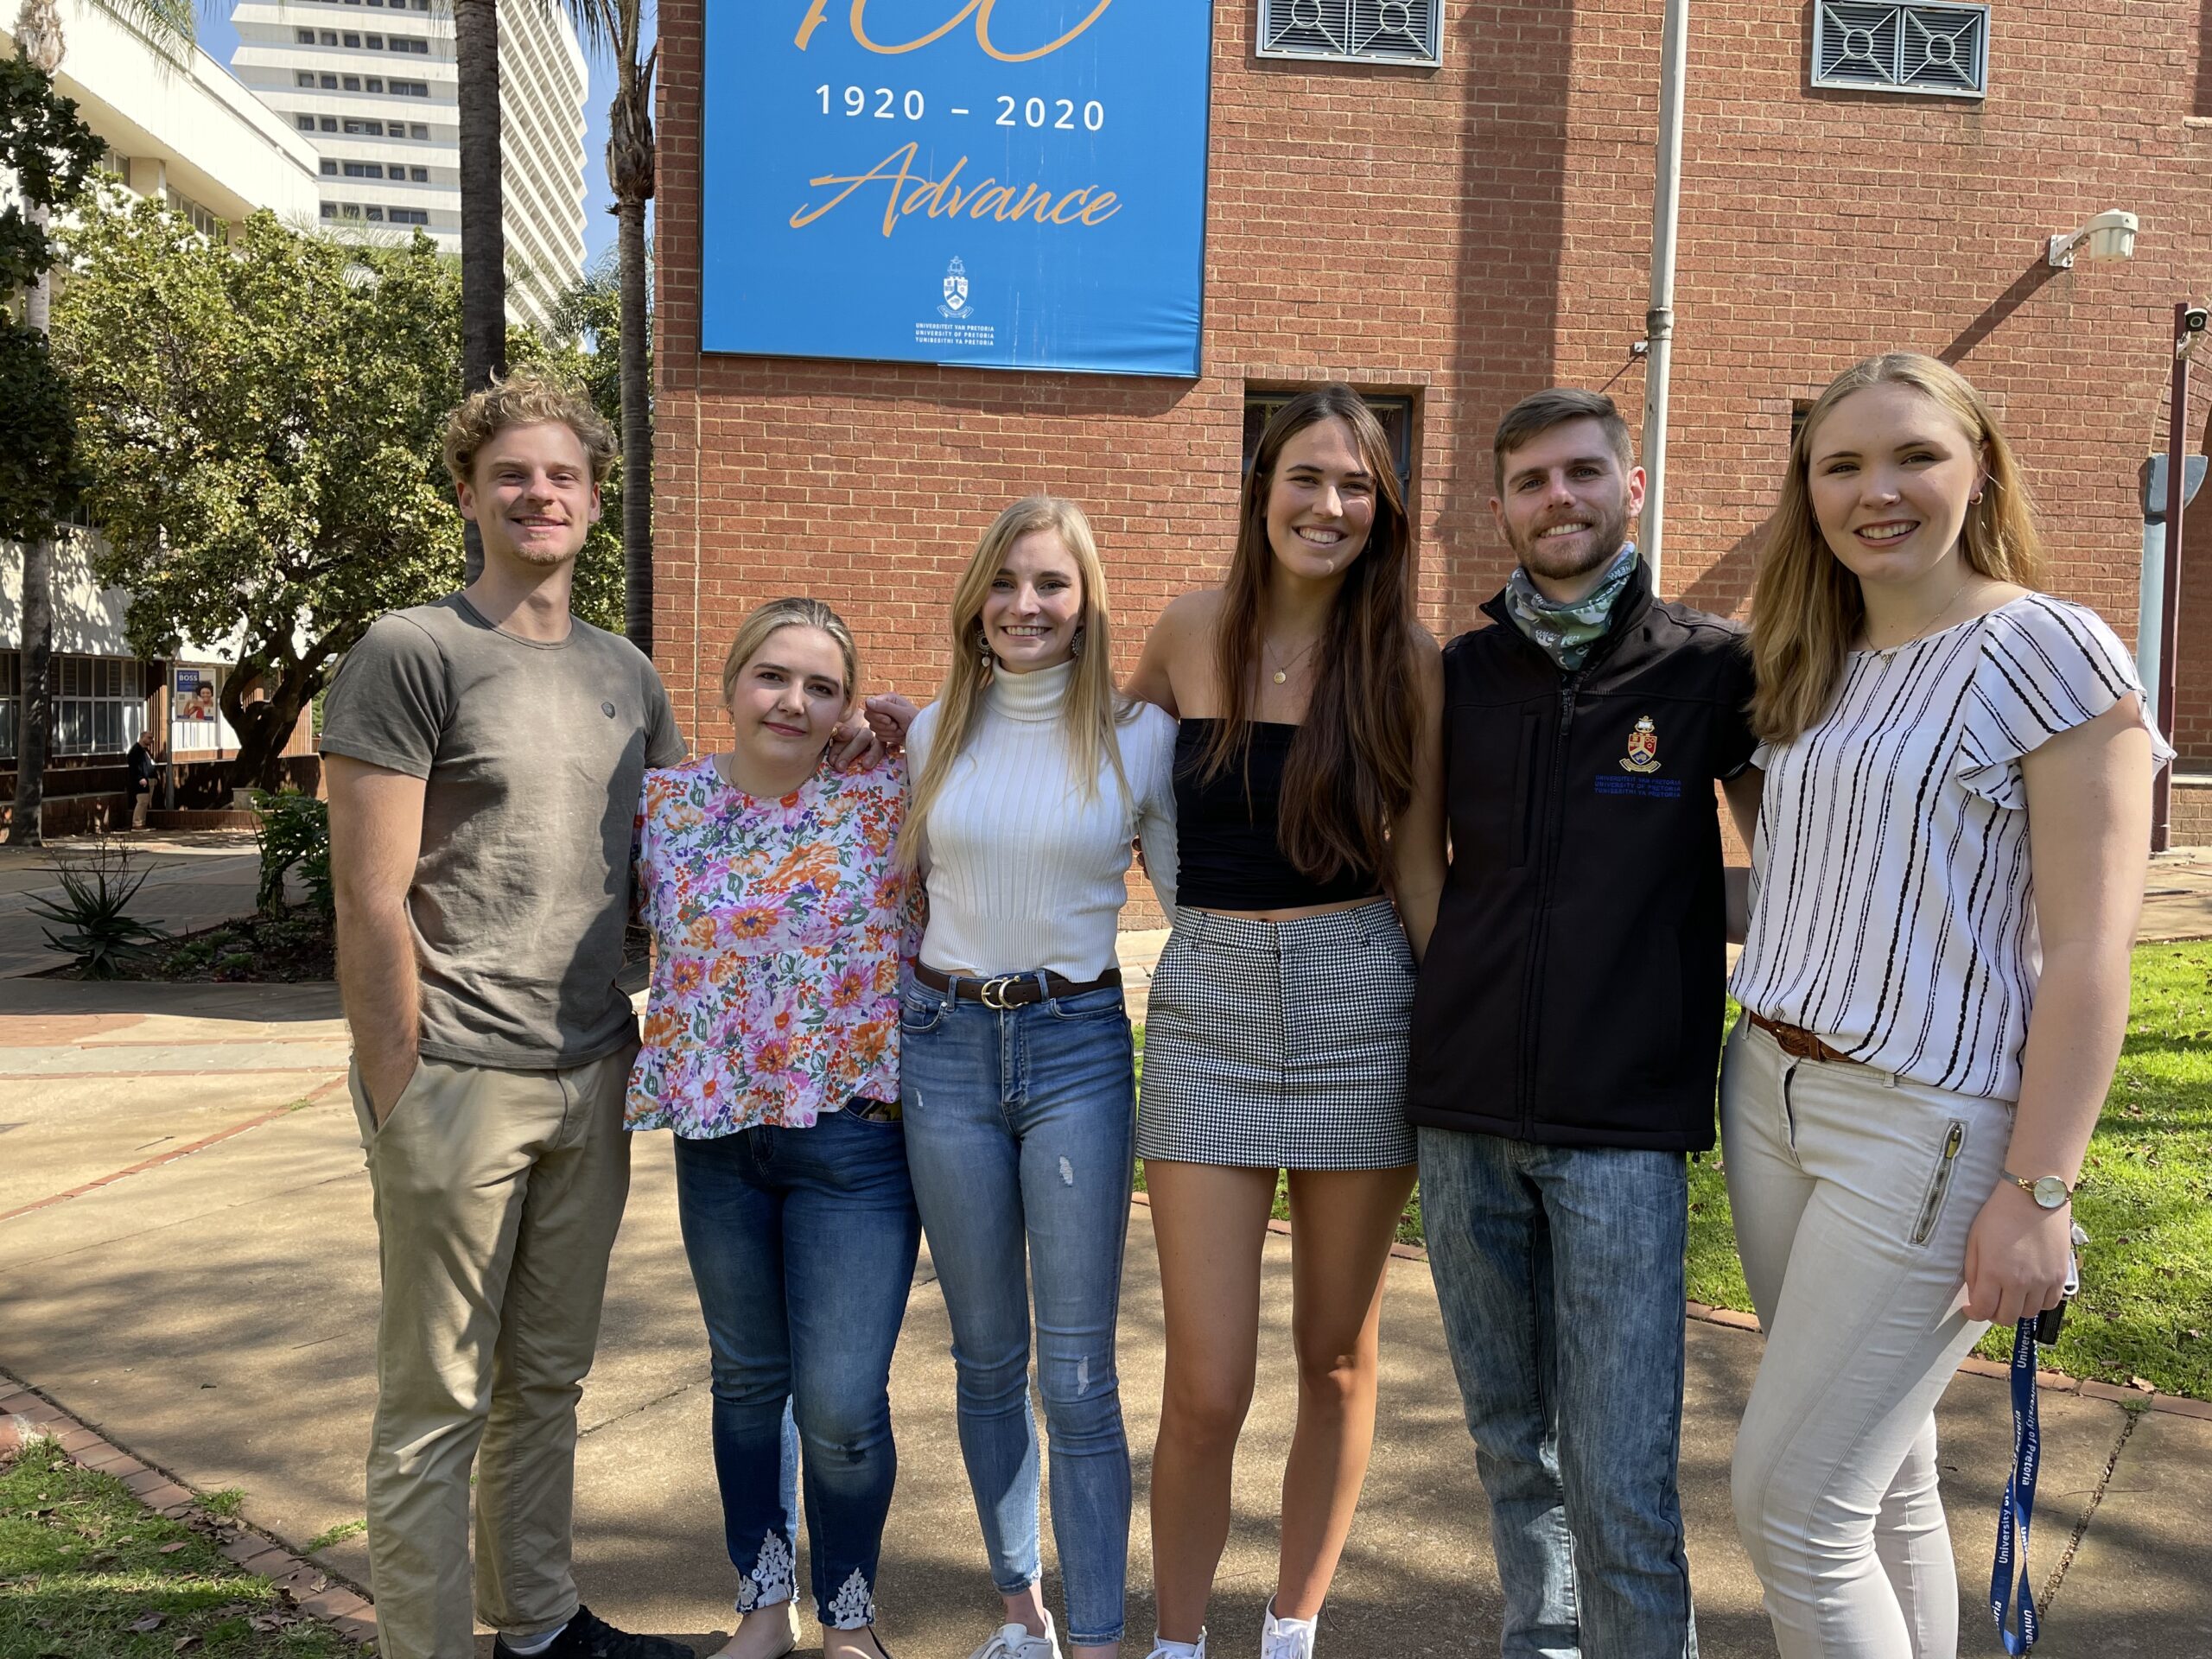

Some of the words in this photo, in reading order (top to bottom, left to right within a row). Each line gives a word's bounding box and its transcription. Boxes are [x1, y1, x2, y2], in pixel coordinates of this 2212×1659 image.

[816, 84, 925, 120] 1920
[995, 95, 1104, 131] 2020
[789, 141, 1123, 238] Advance
[2028, 1432, 2037, 1444] of
[2022, 1444, 2037, 1486] Pretoria
[1999, 1510, 2012, 1564] University
